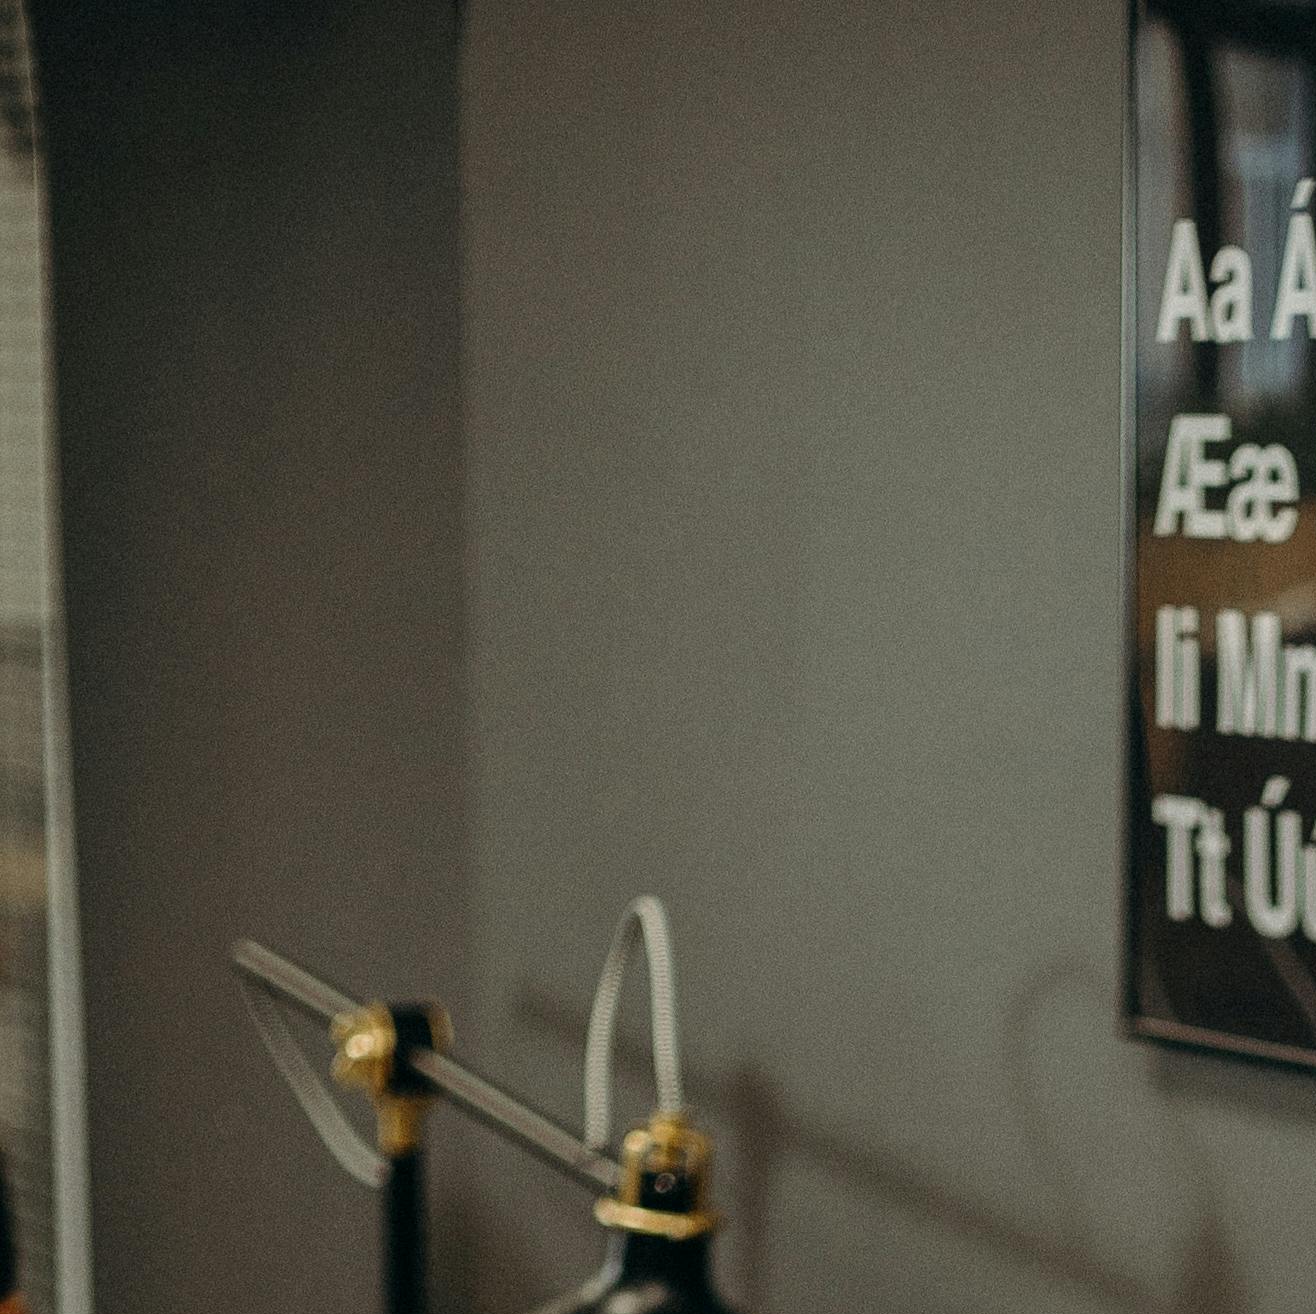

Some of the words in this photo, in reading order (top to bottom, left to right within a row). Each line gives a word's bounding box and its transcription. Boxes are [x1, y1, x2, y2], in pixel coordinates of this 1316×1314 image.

[1154, 218, 1254, 345] Aa
[1154, 414, 1299, 543] Ææ
[1156, 605, 1200, 729] Ii
[1152, 794, 1233, 926] Tt
